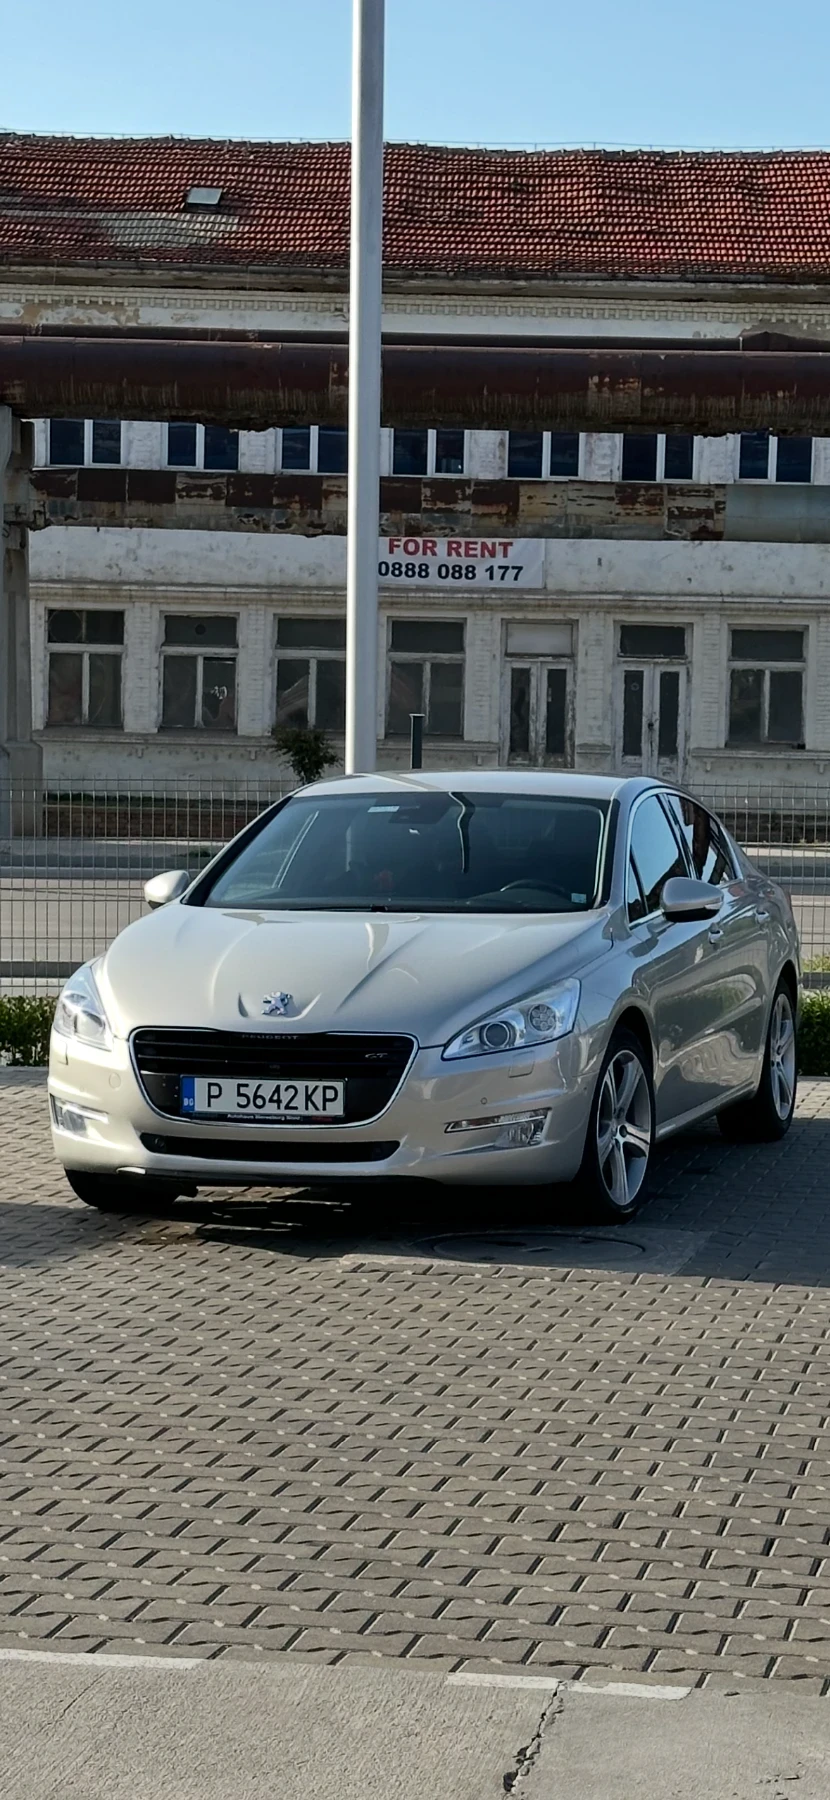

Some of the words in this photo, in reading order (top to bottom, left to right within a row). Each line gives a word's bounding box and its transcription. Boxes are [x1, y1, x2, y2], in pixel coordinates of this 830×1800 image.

[388, 538, 438, 557] FOR
[447, 540, 513, 558] RENT
[378, 561, 430, 579] 0888
[437, 564, 477, 580] 088
[485, 565, 524, 581] 177
[207, 1082, 223, 1108] P
[236, 1083, 299, 1110] 5642
[304, 1085, 339, 1111] KP
